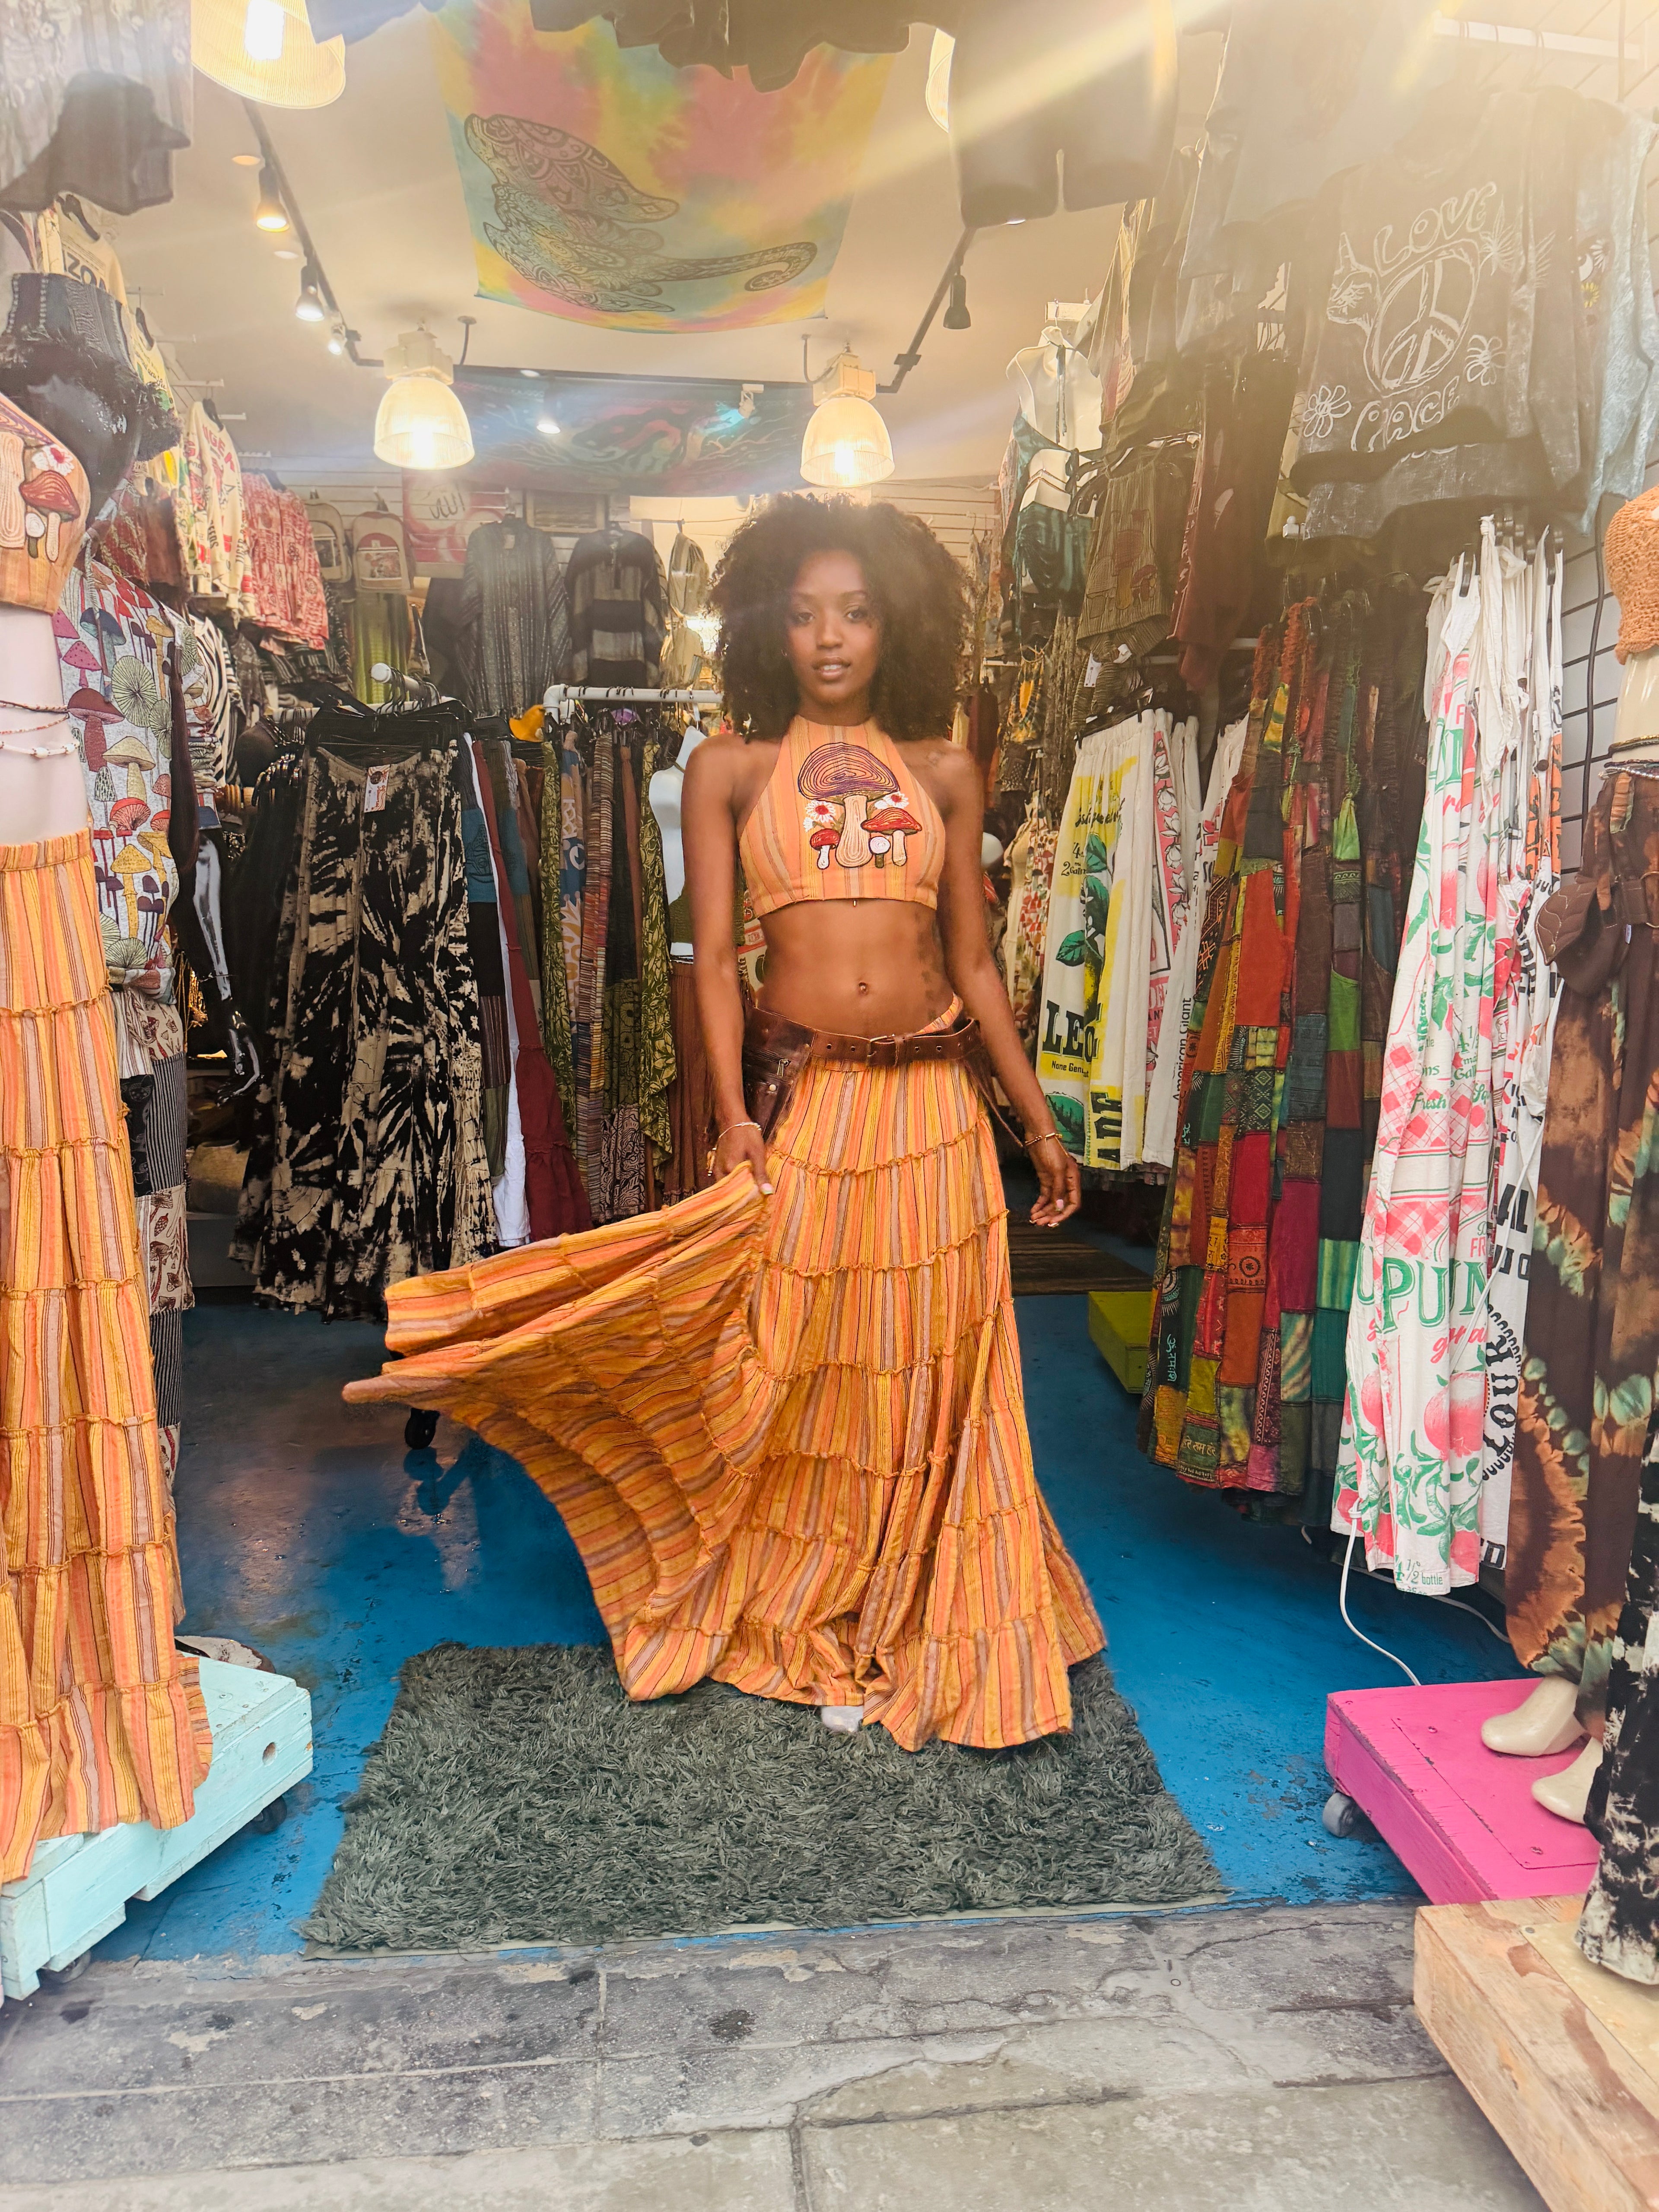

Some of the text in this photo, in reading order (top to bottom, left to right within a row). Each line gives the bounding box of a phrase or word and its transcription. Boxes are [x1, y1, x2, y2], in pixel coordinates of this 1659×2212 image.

[1373, 181, 1497, 277] LOVE
[1052, 1060, 1067, 1071] None
[1411, 1091, 1447, 1114] Fresh
[1421, 1572, 1443, 1586] bottle
